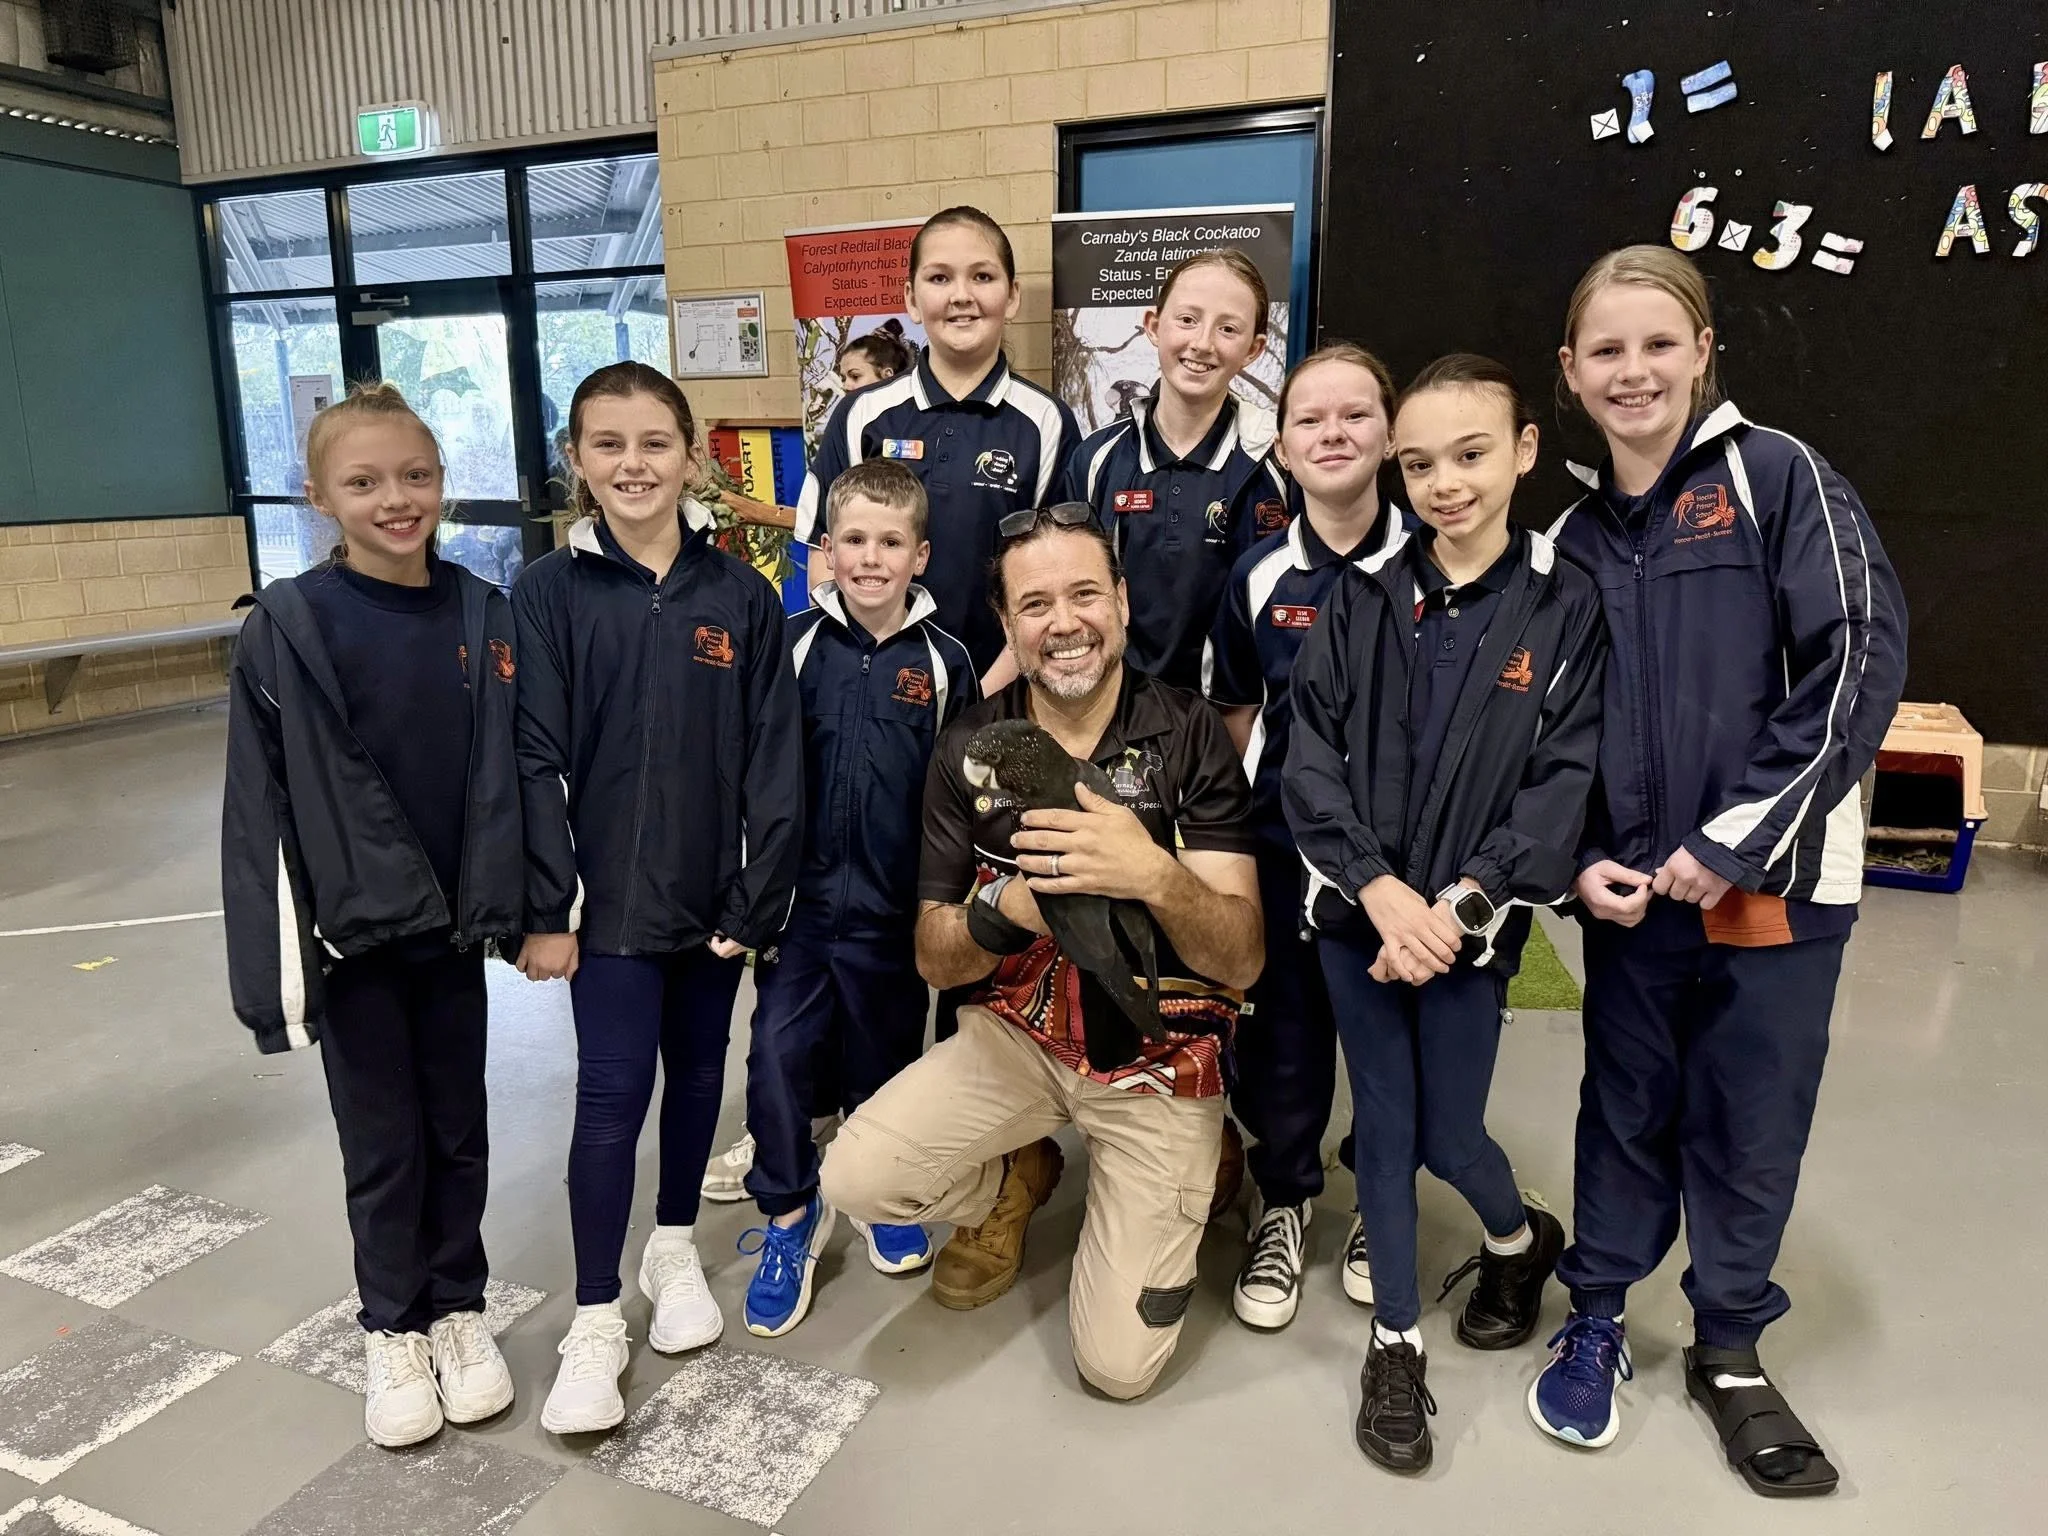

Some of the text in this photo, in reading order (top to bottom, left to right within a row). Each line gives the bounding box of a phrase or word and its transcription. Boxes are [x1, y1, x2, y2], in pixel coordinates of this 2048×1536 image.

[1081, 226, 1261, 247] Carnaby's Black Cockatoo
[801, 244, 838, 257] Forest
[840, 239, 881, 254] Redtail
[1114, 249, 1158, 263] Zanda
[803, 257, 898, 277] Calyptorhynchus
[1099, 268, 1142, 282] Status
[832, 278, 869, 291] Status
[824, 294, 878, 311] Expected
[1091, 286, 1154, 303] Expected
